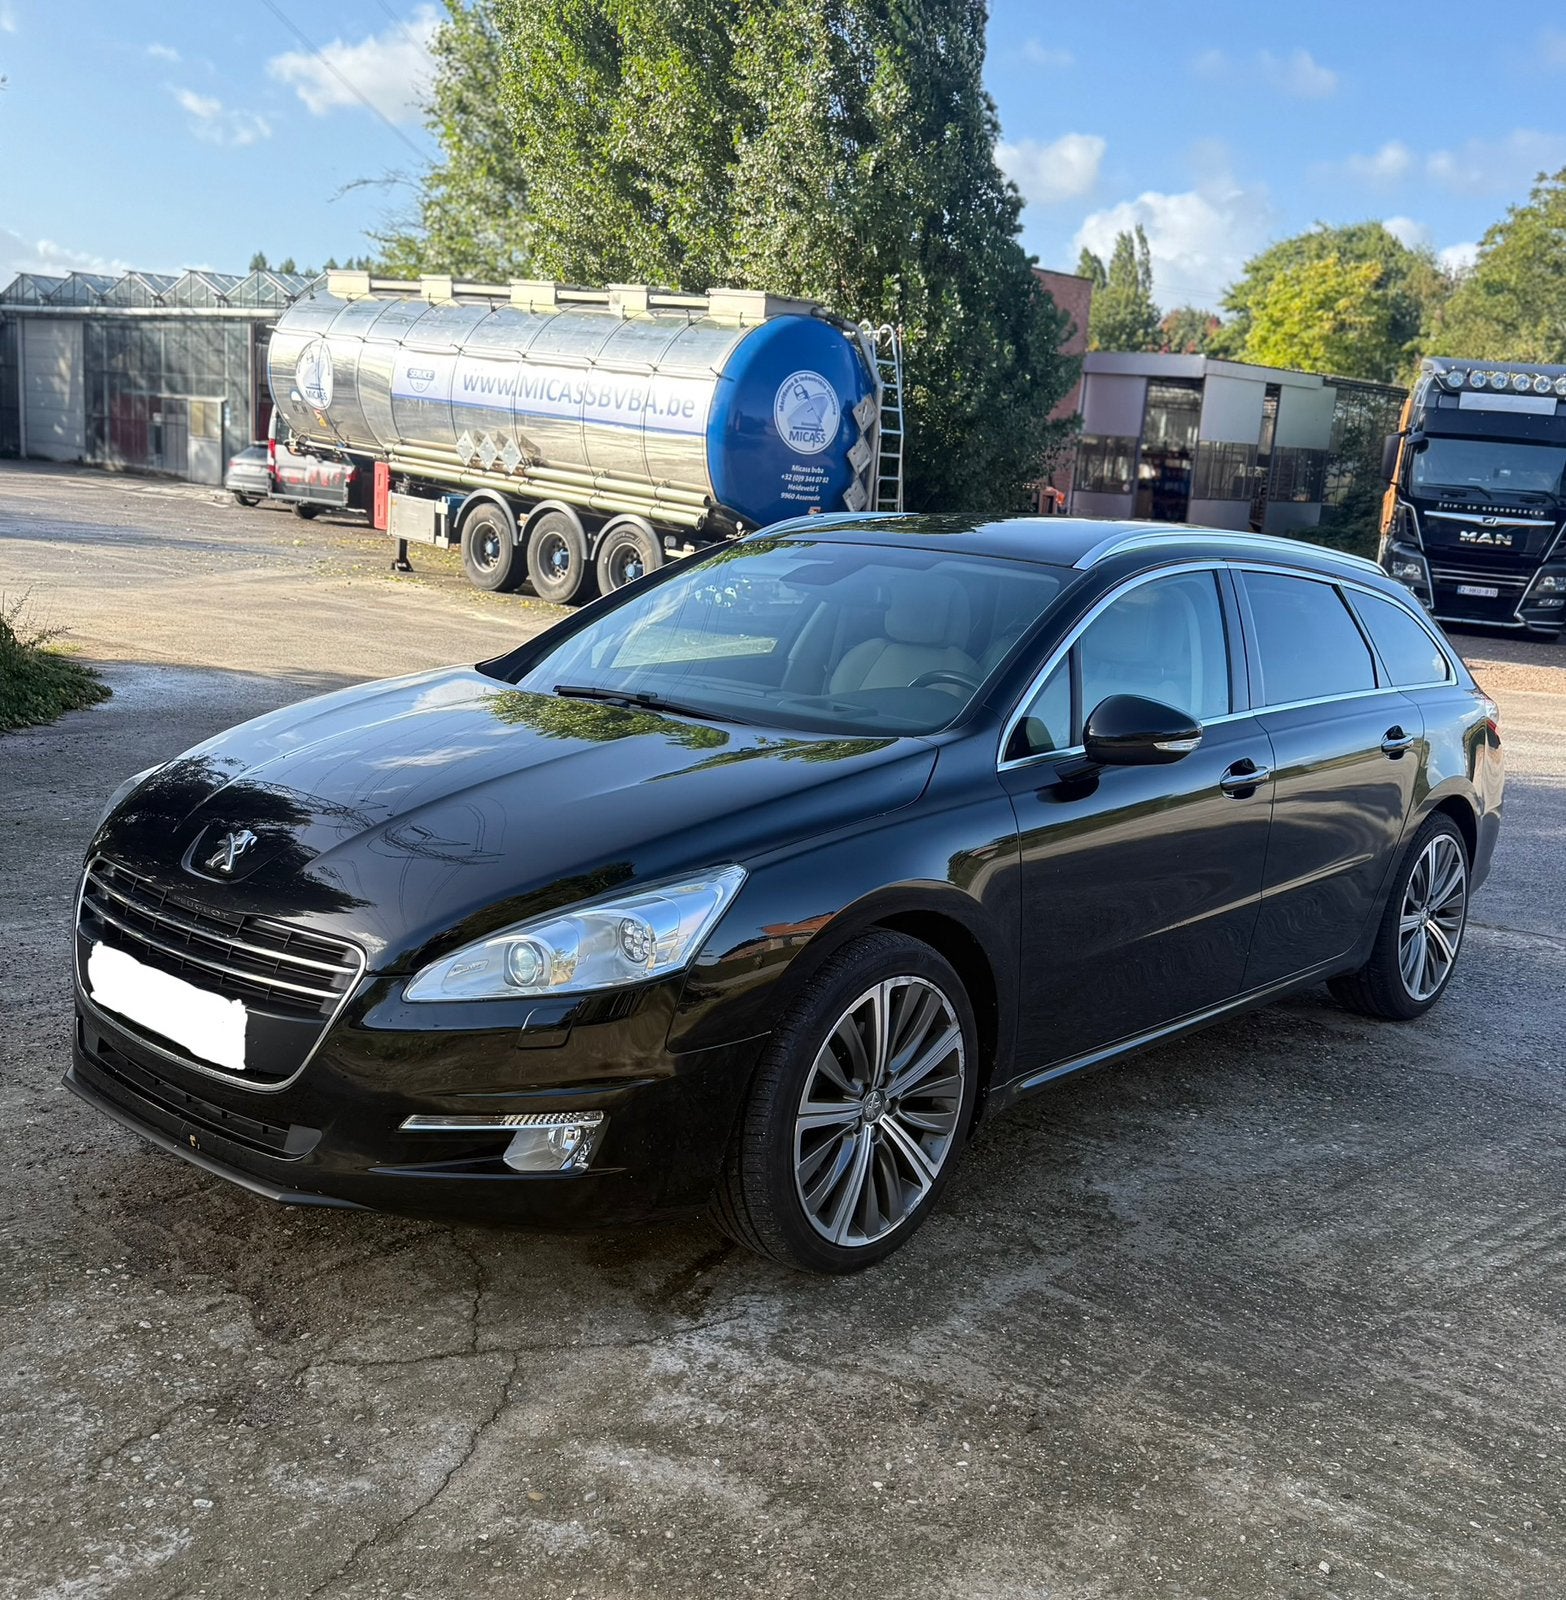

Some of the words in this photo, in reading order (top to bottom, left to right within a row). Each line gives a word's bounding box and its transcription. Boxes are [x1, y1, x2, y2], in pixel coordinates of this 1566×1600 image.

[463, 373, 696, 419] www.MICASSBVBA.be
[788, 430, 826, 444] MICASS
[791, 464, 810, 473] Micass
[811, 466, 824, 474] bvba
[781, 473, 792, 481] +32
[1460, 530, 1513, 546] MAN
